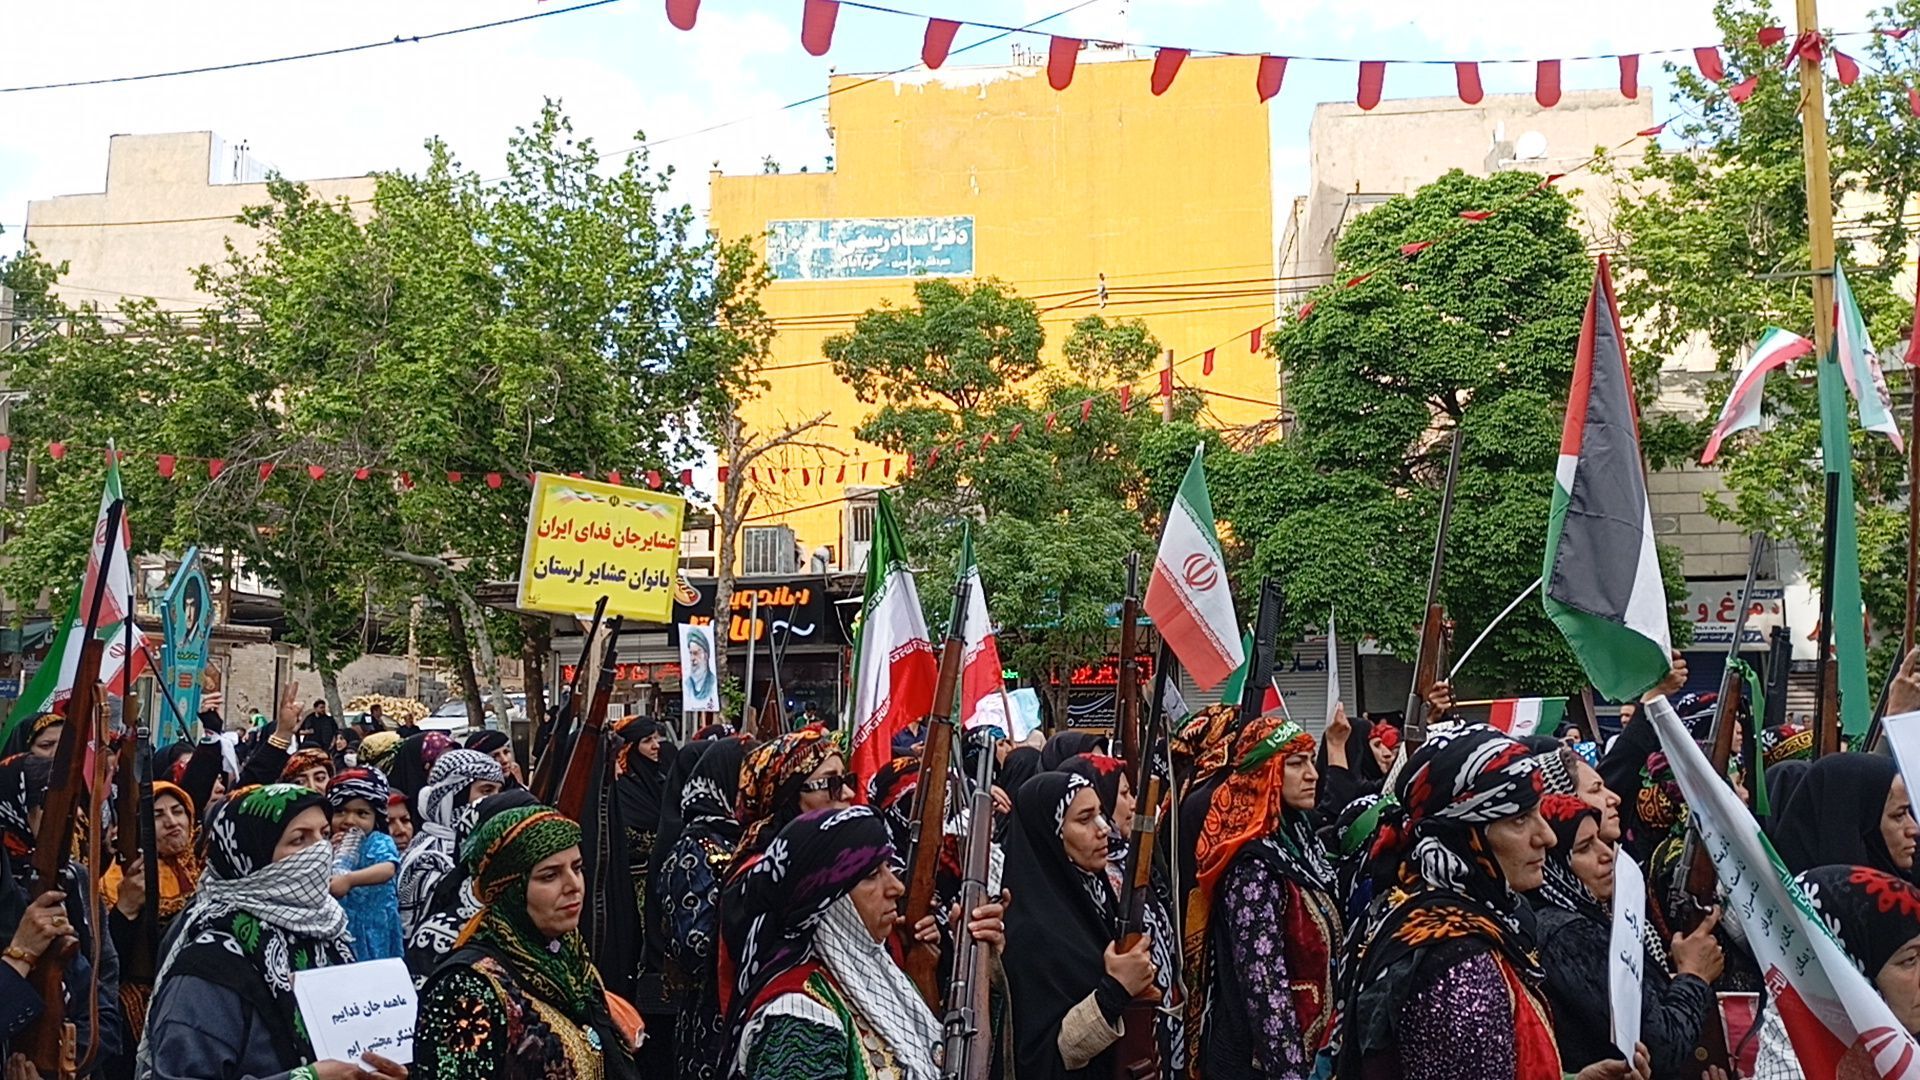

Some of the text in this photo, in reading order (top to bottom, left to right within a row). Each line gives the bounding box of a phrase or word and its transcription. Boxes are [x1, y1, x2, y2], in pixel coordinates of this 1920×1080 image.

[537, 515, 677, 551] عشایر جان فدای ایران
[533, 555, 584, 583] لرستان
[584, 562, 627, 585] عشایر
[628, 568, 670, 593] بانوان
[729, 585, 810, 611] ساندوی
[1715, 591, 1764, 623] مغ
[331, 1002, 360, 1024] فداییم
[363, 1000, 381, 1017] جان
[346, 1040, 361, 1058] ایم
